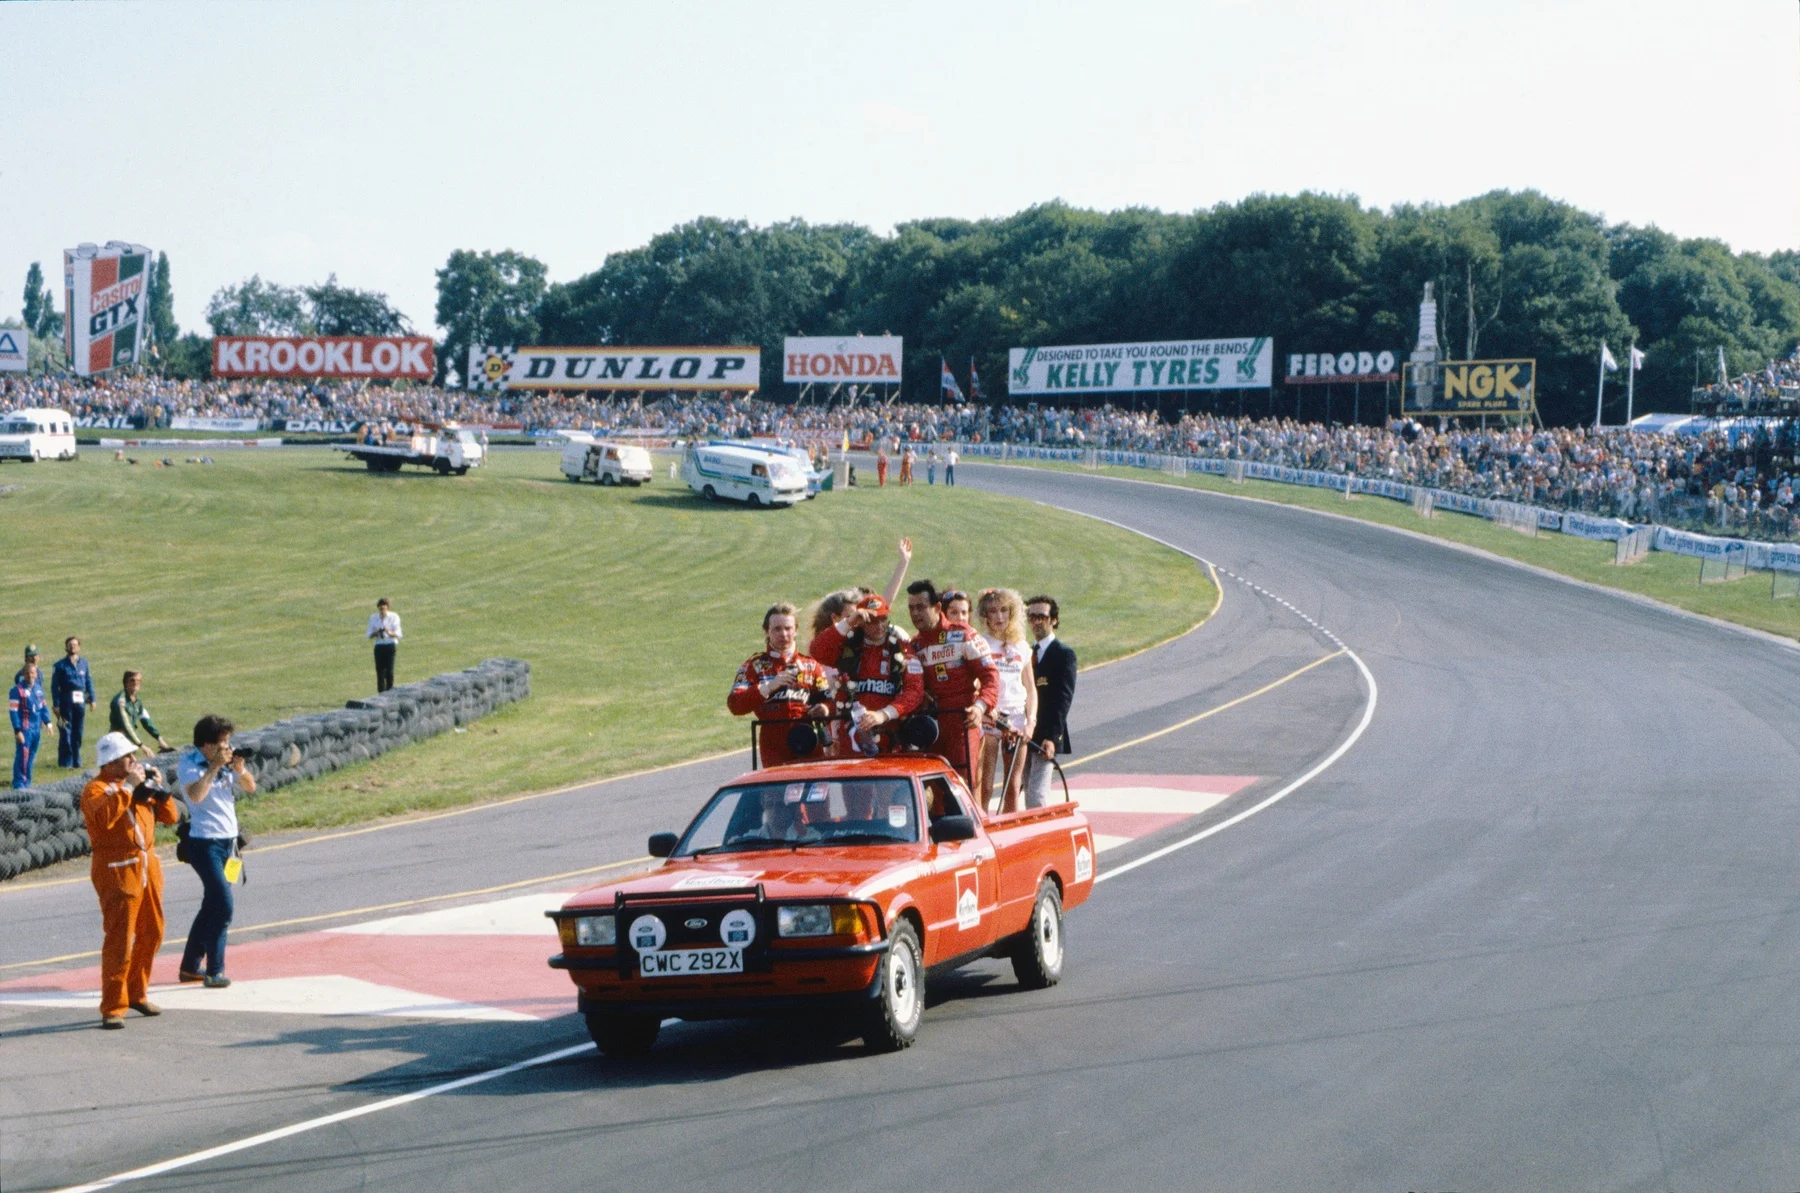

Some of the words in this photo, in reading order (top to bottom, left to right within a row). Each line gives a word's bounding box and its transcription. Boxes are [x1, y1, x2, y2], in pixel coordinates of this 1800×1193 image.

[90, 273, 143, 314] Castrol
[90, 292, 141, 336] GTX
[217, 340, 429, 374] KROOKLOK
[1036, 349, 1083, 362] DESIGNED
[1085, 348, 1099, 360] TO
[1100, 347, 1123, 359] TAKE
[1126, 346, 1148, 358] YOU
[1150, 344, 1188, 357] ROUND
[1192, 343, 1210, 355] THE
[1213, 342, 1248, 355] BENDS
[1289, 350, 1395, 376] FERODO
[523, 356, 746, 380] DUNLOP
[786, 353, 898, 377] HONDA
[1046, 361, 1121, 389] KELLY
[1132, 357, 1220, 386] TYRES
[1444, 364, 1521, 399] NGK
[1458, 400, 1481, 408] SPARK
[1484, 400, 1507, 408] PLUGS
[72, 416, 135, 430] MAIL
[285, 420, 357, 433] DAILY
[642, 955, 681, 973] CWC
[688, 951, 740, 971] 292X
